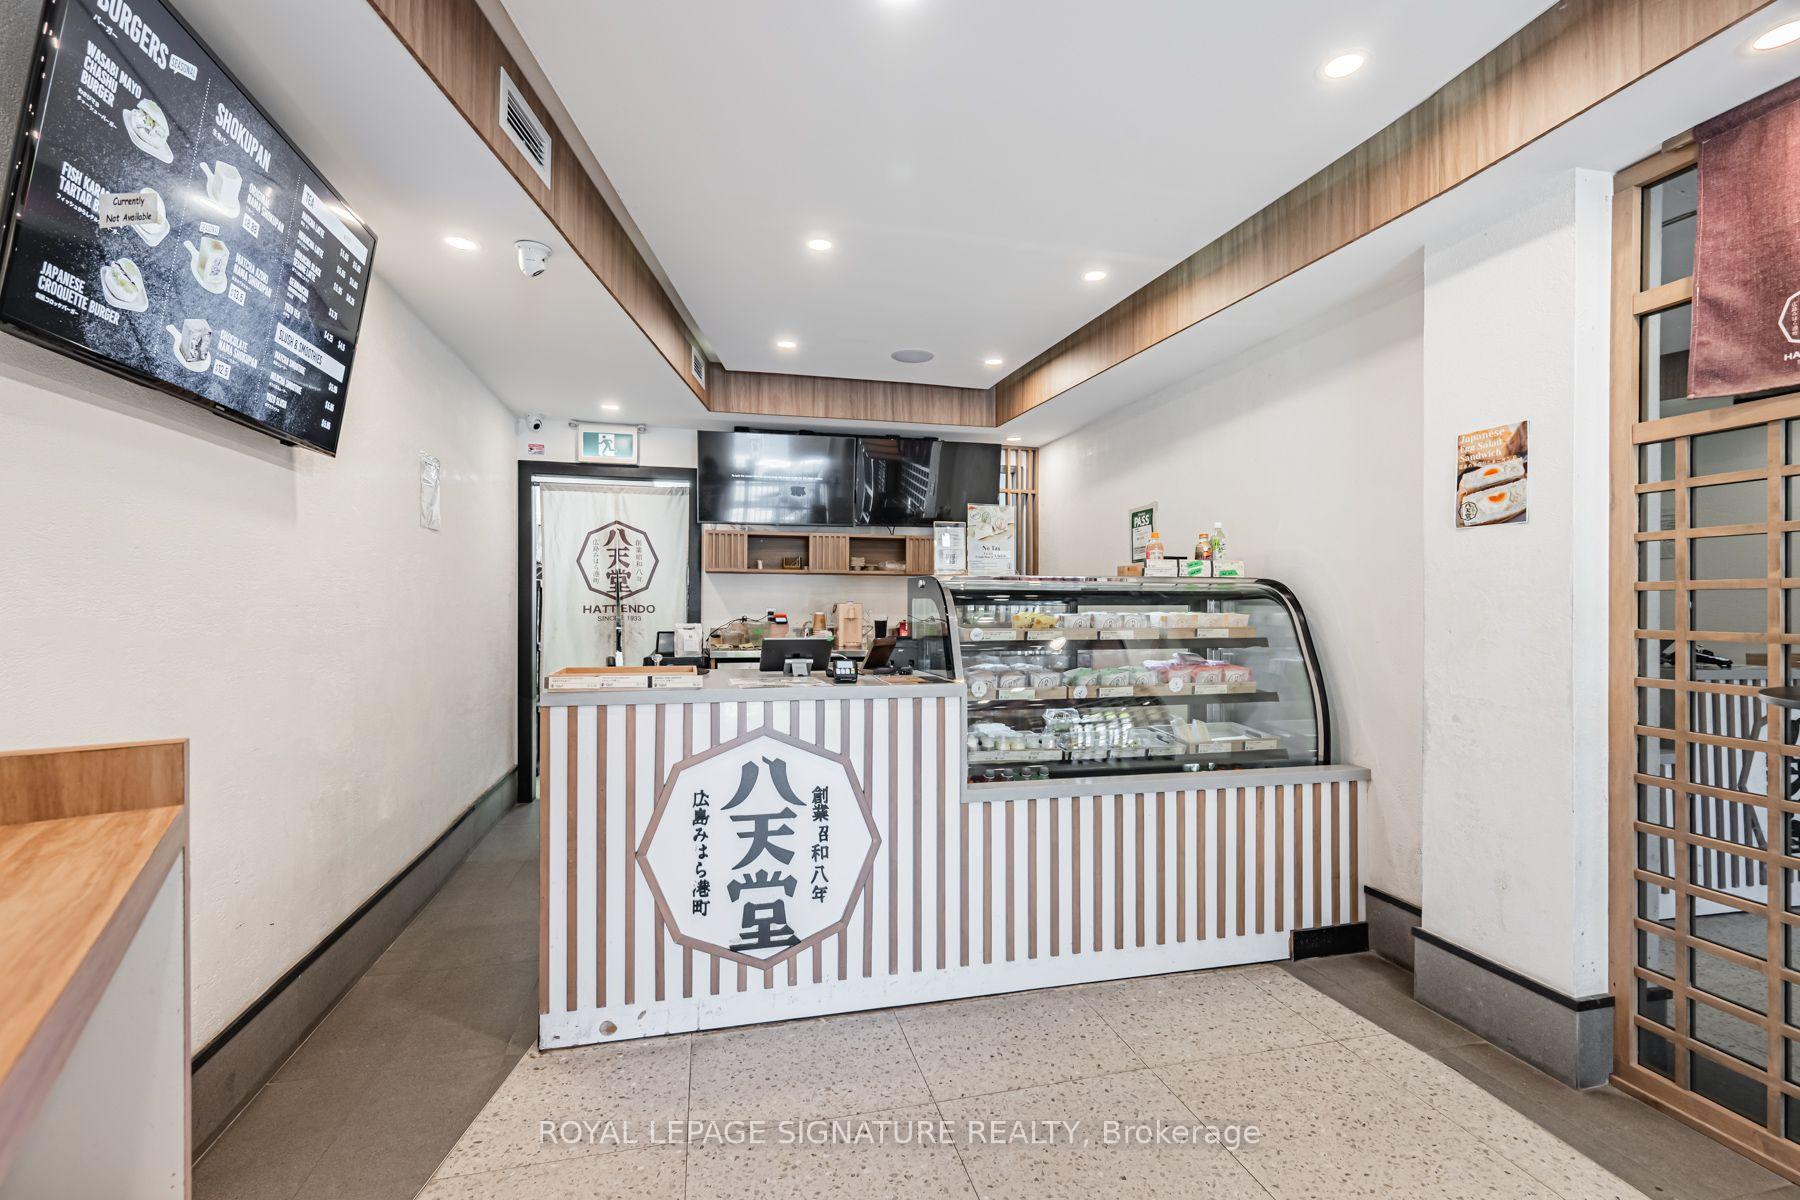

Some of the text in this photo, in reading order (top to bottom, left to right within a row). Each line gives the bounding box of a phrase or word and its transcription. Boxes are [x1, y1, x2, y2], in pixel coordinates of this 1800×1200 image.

[83, 55, 119, 94] CHASHU
[87, 40, 142, 99] WASABI MAYO
[171, 57, 197, 79] SEASONAL
[80, 69, 116, 108] BURGER
[215, 102, 271, 173] SHOKUPAN
[61, 161, 83, 186] FISH
[60, 175, 93, 208] TARTAR
[113, 197, 145, 207] Currently
[305, 192, 315, 209] TEA
[106, 212, 152, 223] Not Available
[40, 261, 86, 294] JAPANESE
[37, 275, 120, 326] CROQUETTE BURGER
[279, 329, 294, 346] SLUSH
[299, 343, 323, 365] SMOOTHIES
[1460, 448, 1502, 462] Sandwich
[1134, 514, 1150, 527] PASS
[603, 528, 633, 593] 八天堂
[582, 604, 656, 614] HATTENDO
[720, 755, 807, 952] 八天堂
